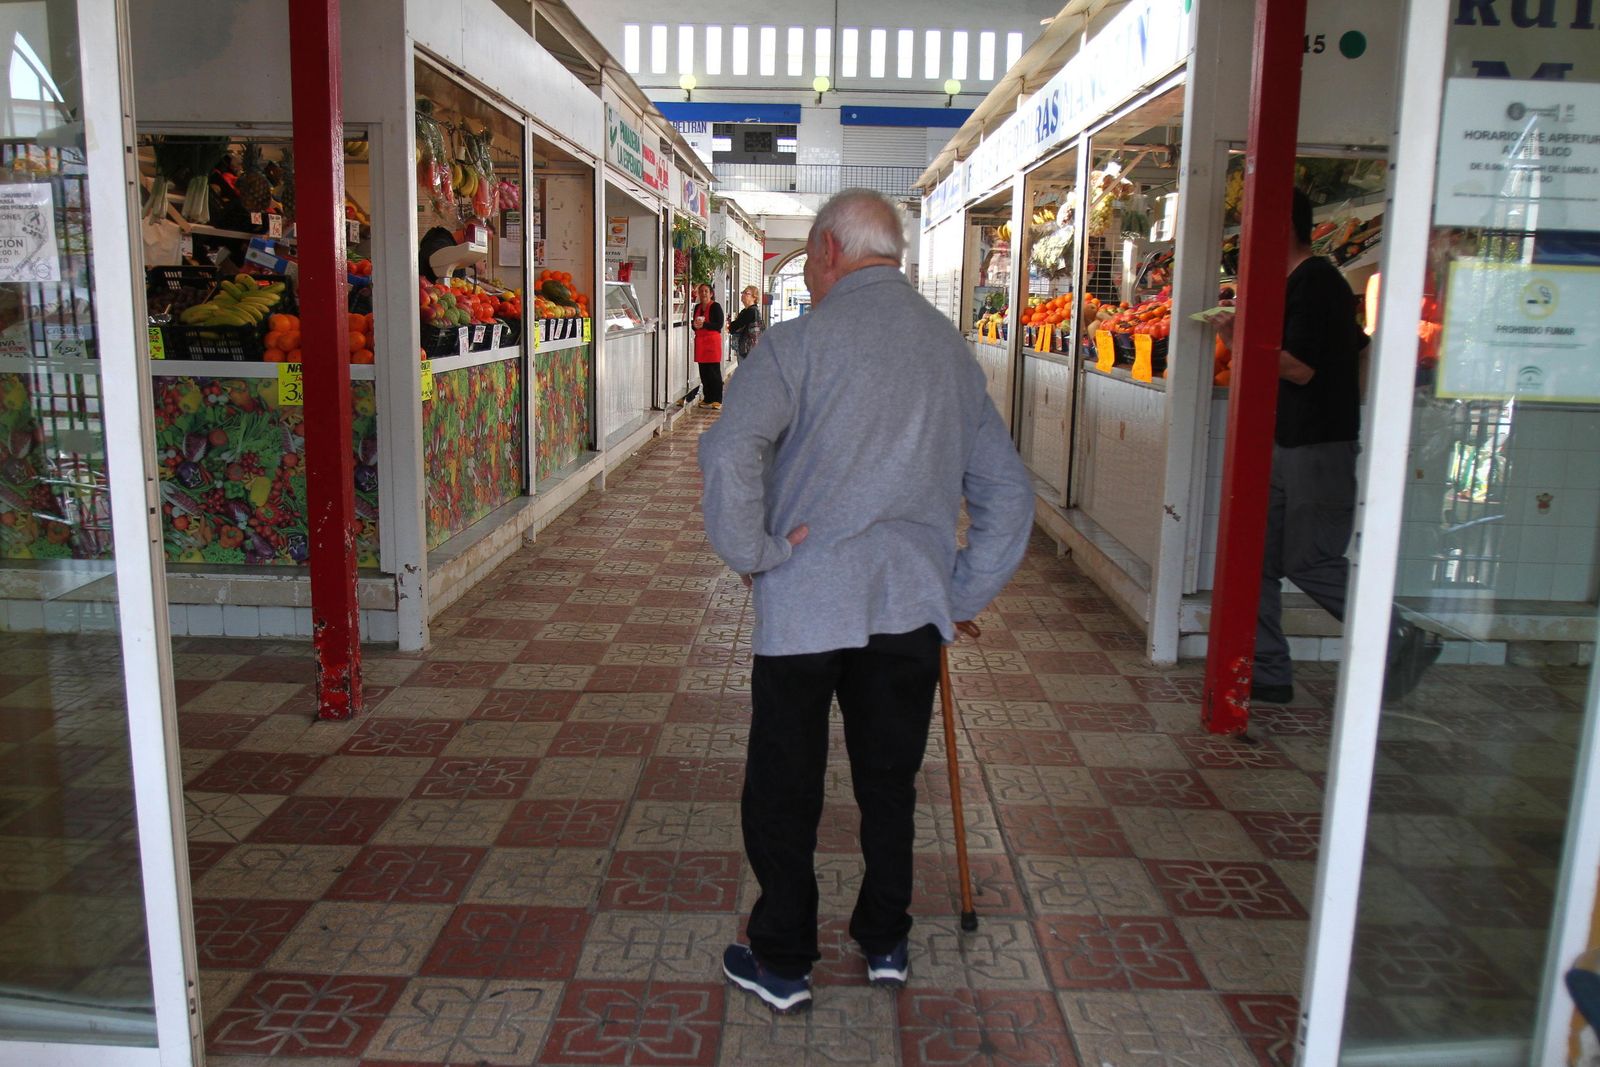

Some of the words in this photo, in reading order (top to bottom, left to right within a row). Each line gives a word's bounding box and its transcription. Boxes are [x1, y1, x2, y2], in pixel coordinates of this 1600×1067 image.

[1531, 132, 1546, 142] E
[1520, 145, 1572, 157] BLICO
[1496, 325, 1542, 335] PROHIBIDO
[1545, 326, 1576, 336] FUMAR
